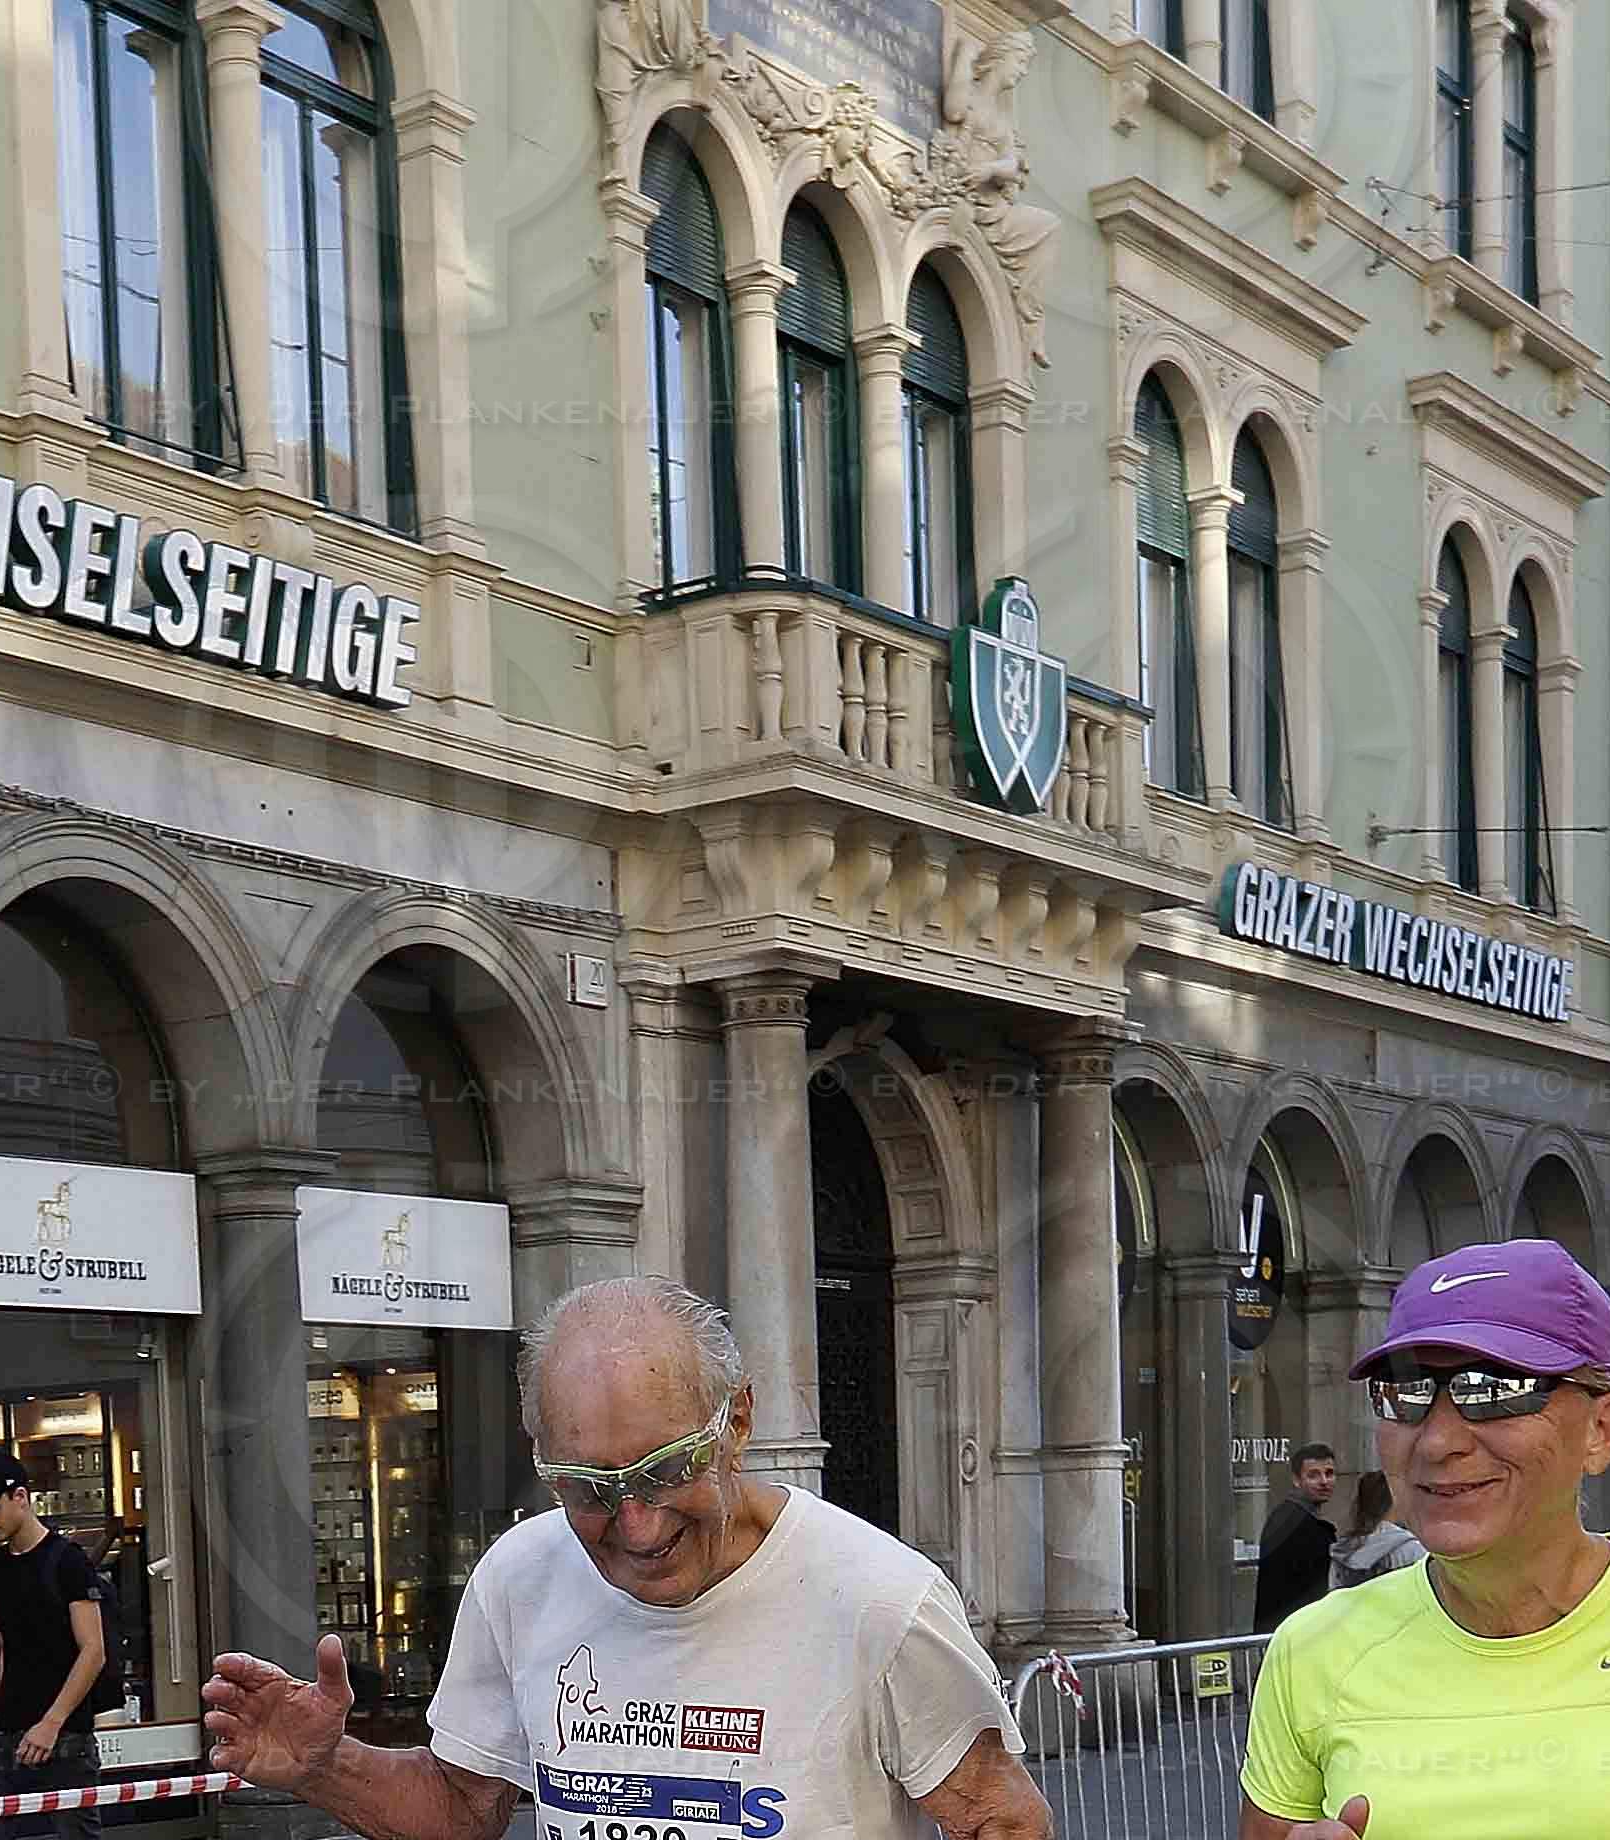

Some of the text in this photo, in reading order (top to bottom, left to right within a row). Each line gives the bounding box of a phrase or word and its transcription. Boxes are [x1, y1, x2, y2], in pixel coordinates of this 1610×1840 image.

[1234, 861, 1573, 1022] GRAZER WECHSELSEITIGE
[39, 1249, 63, 1281] &
[65, 1258, 147, 1281] STRUBELL
[332, 1273, 470, 1301] NÄGELE & STRUBELL
[625, 1701, 760, 1731] GRAZ KLEINE
[570, 1720, 758, 1750] MARATHON ZEITUNG
[562, 1791, 610, 1804] MARATHON
[571, 1775, 625, 1794] GRAZ
[596, 1805, 618, 1814] 2018
[674, 1805, 718, 1819] GRAZ
